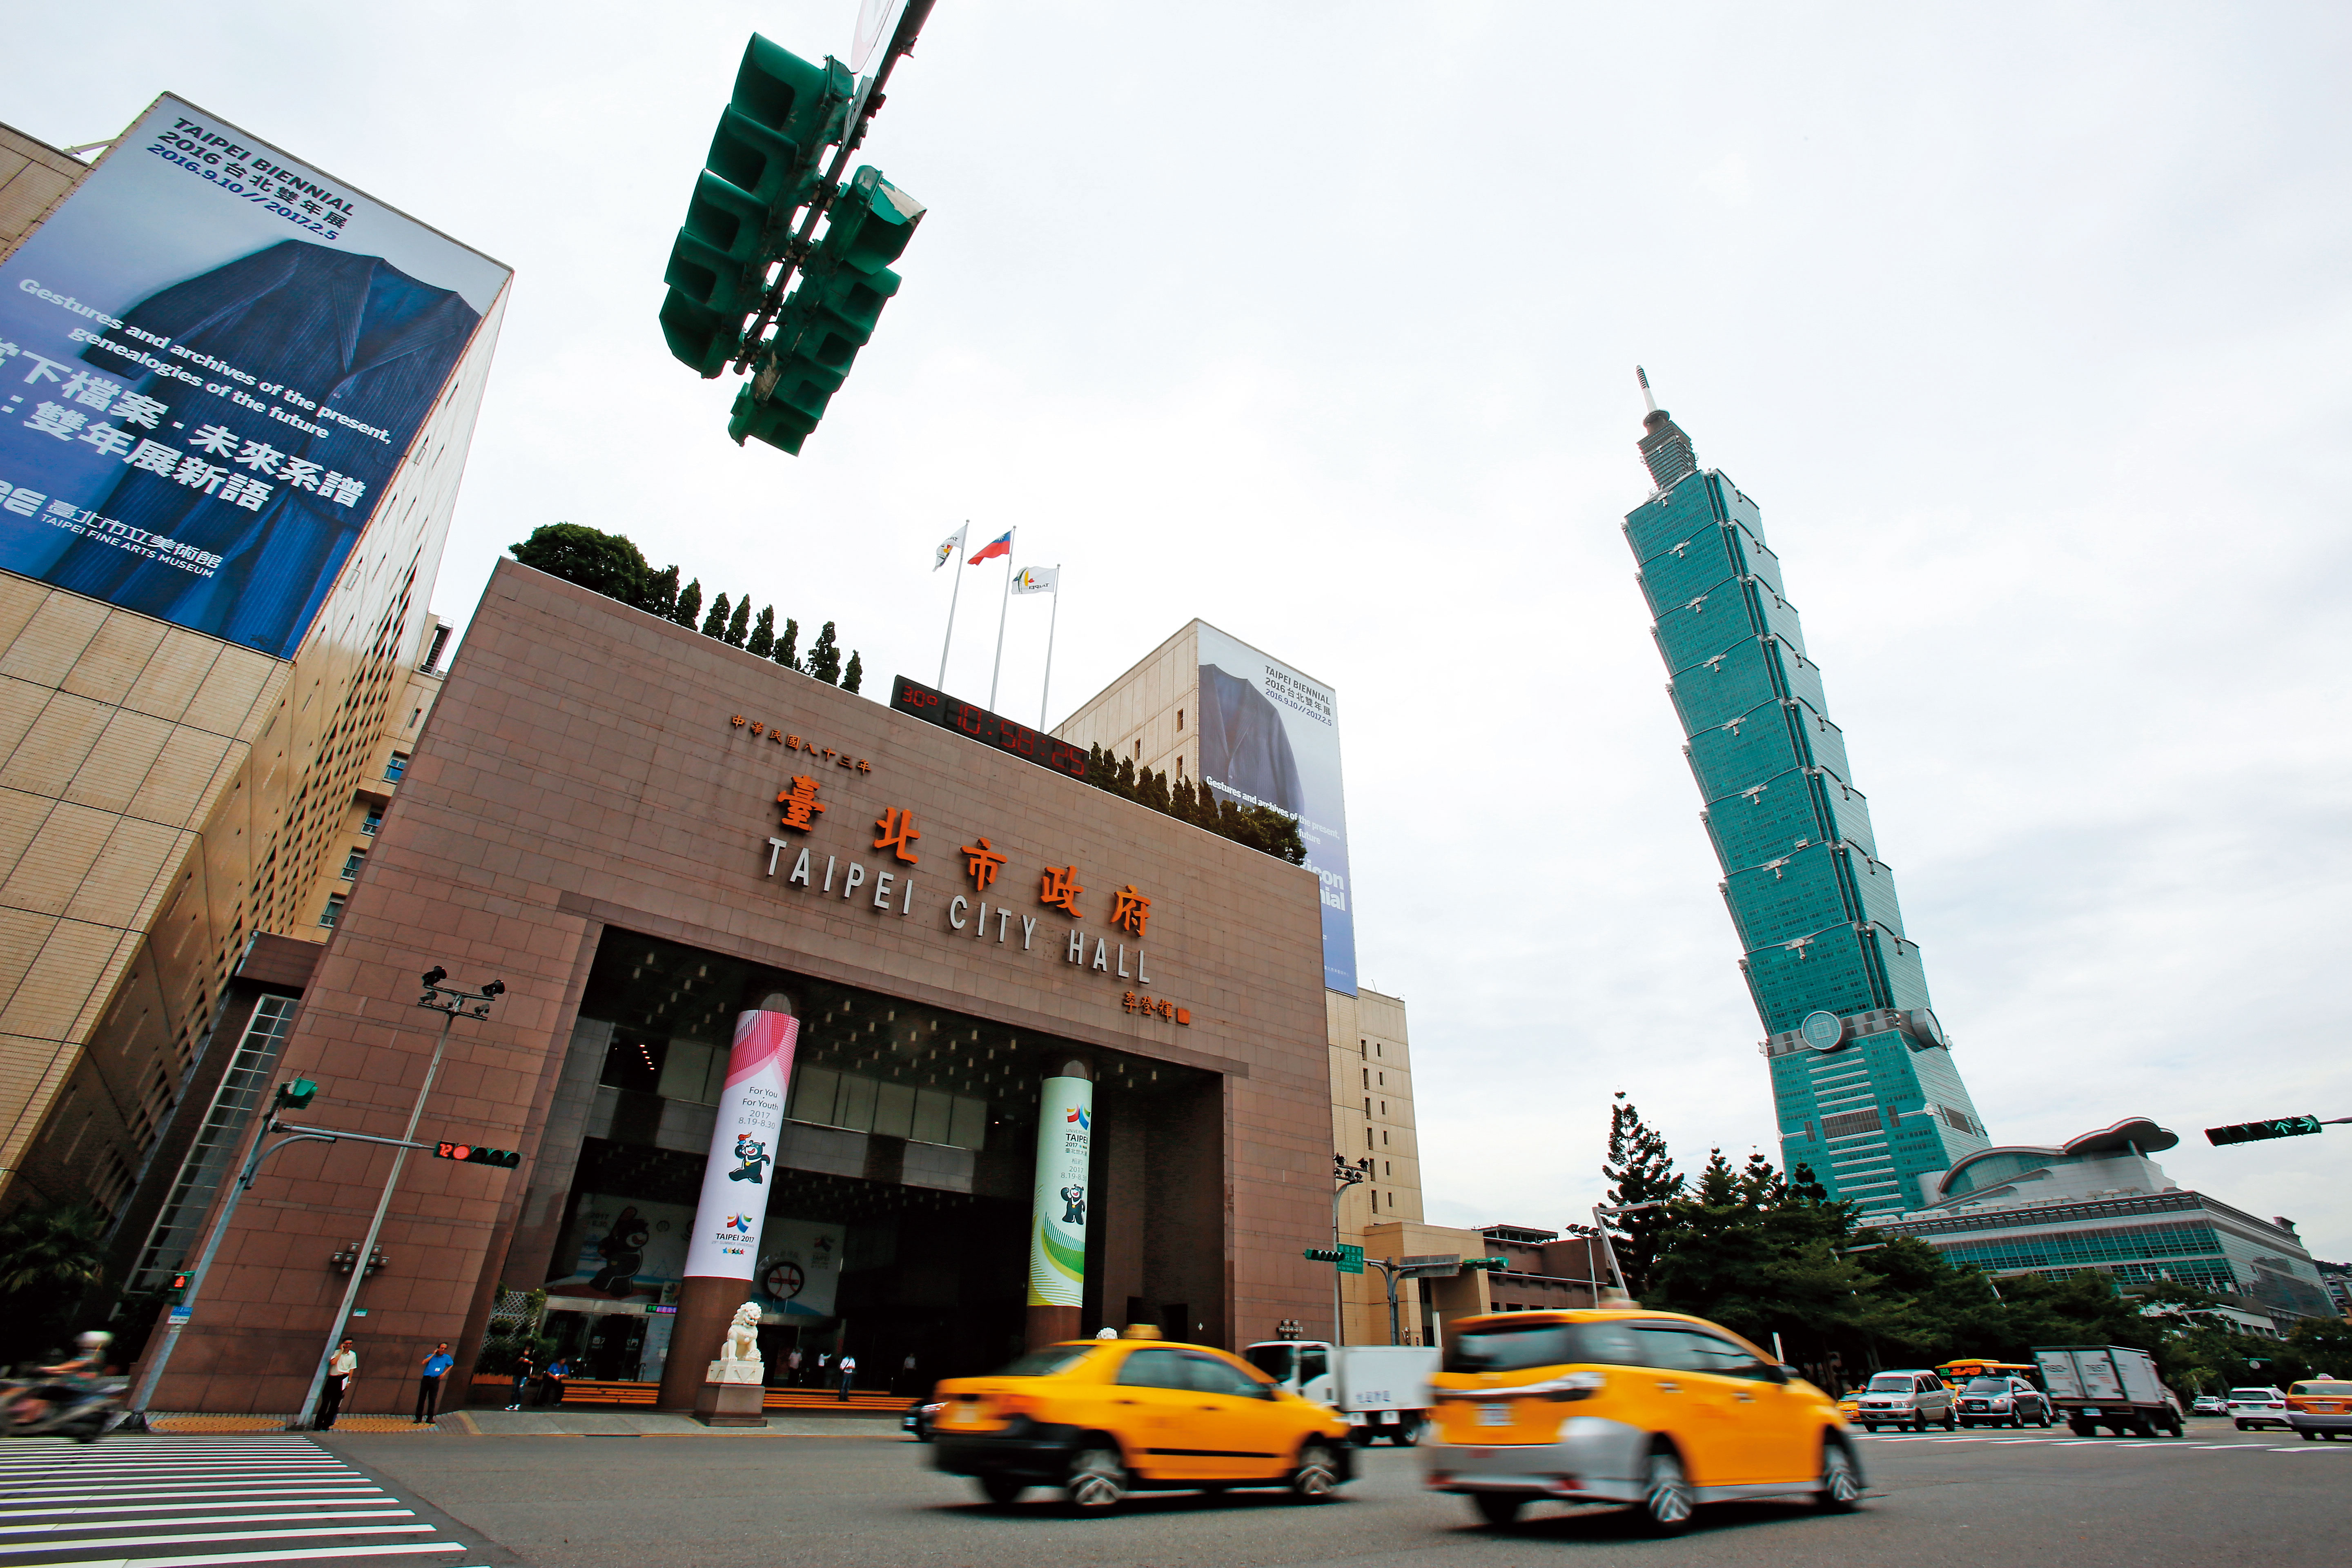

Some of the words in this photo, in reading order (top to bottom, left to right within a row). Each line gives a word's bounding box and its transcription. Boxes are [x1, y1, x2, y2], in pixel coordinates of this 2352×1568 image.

[157, 131, 223, 165] 2016
[224, 162, 348, 229] 台北雙年展
[174, 117, 252, 161] TAIPEI
[251, 158, 354, 216] BIENNIAL
[19, 278, 125, 330] Gestures
[125, 326, 172, 349] and
[170, 344, 257, 386] archives
[259, 374, 285, 396] of
[284, 385, 317, 410] the
[317, 404, 392, 445] present,
[68, 328, 205, 387] genealogies
[206, 378, 232, 398] of
[232, 388, 267, 413] the
[269, 406, 330, 439] future
[42, 514, 87, 535] TAIPEI
[87, 530, 121, 546] FINE
[120, 542, 157, 558] ARTS
[158, 554, 215, 578] MUSEUM
[46, 499, 224, 569] 臺北市立美術館
[1265, 665, 1291, 685] TAIPEI
[1293, 679, 1330, 705] BIENNIAL
[1265, 677, 1285, 693] 2016
[1287, 688, 1331, 717] 台北雙年展
[731, 714, 872, 775] 中華民國八十三年
[1206, 775, 1241, 798] Gestures
[1242, 792, 1257, 805] and
[1258, 799, 1289, 818] archives
[1290, 811, 1298, 820] of
[1298, 814, 1311, 826] the
[1312, 822, 1340, 840] present,
[1298, 828, 1321, 845] future
[777, 775, 1152, 938] 臺北市政府
[768, 836, 913, 916] TAIPEI
[949, 894, 1037, 951] CITY
[1068, 929, 1150, 984] HALL
[1123, 991, 1173, 1022] 李登輝
[738, 1117, 775, 1129] 8.19-8.30
[749, 1087, 763, 1095] For
[765, 1089, 778, 1098] You
[750, 1110, 771, 1119] 2017
[758, 1100, 778, 1111] Youth
[1065, 1134, 1088, 1144] TAIPEI
